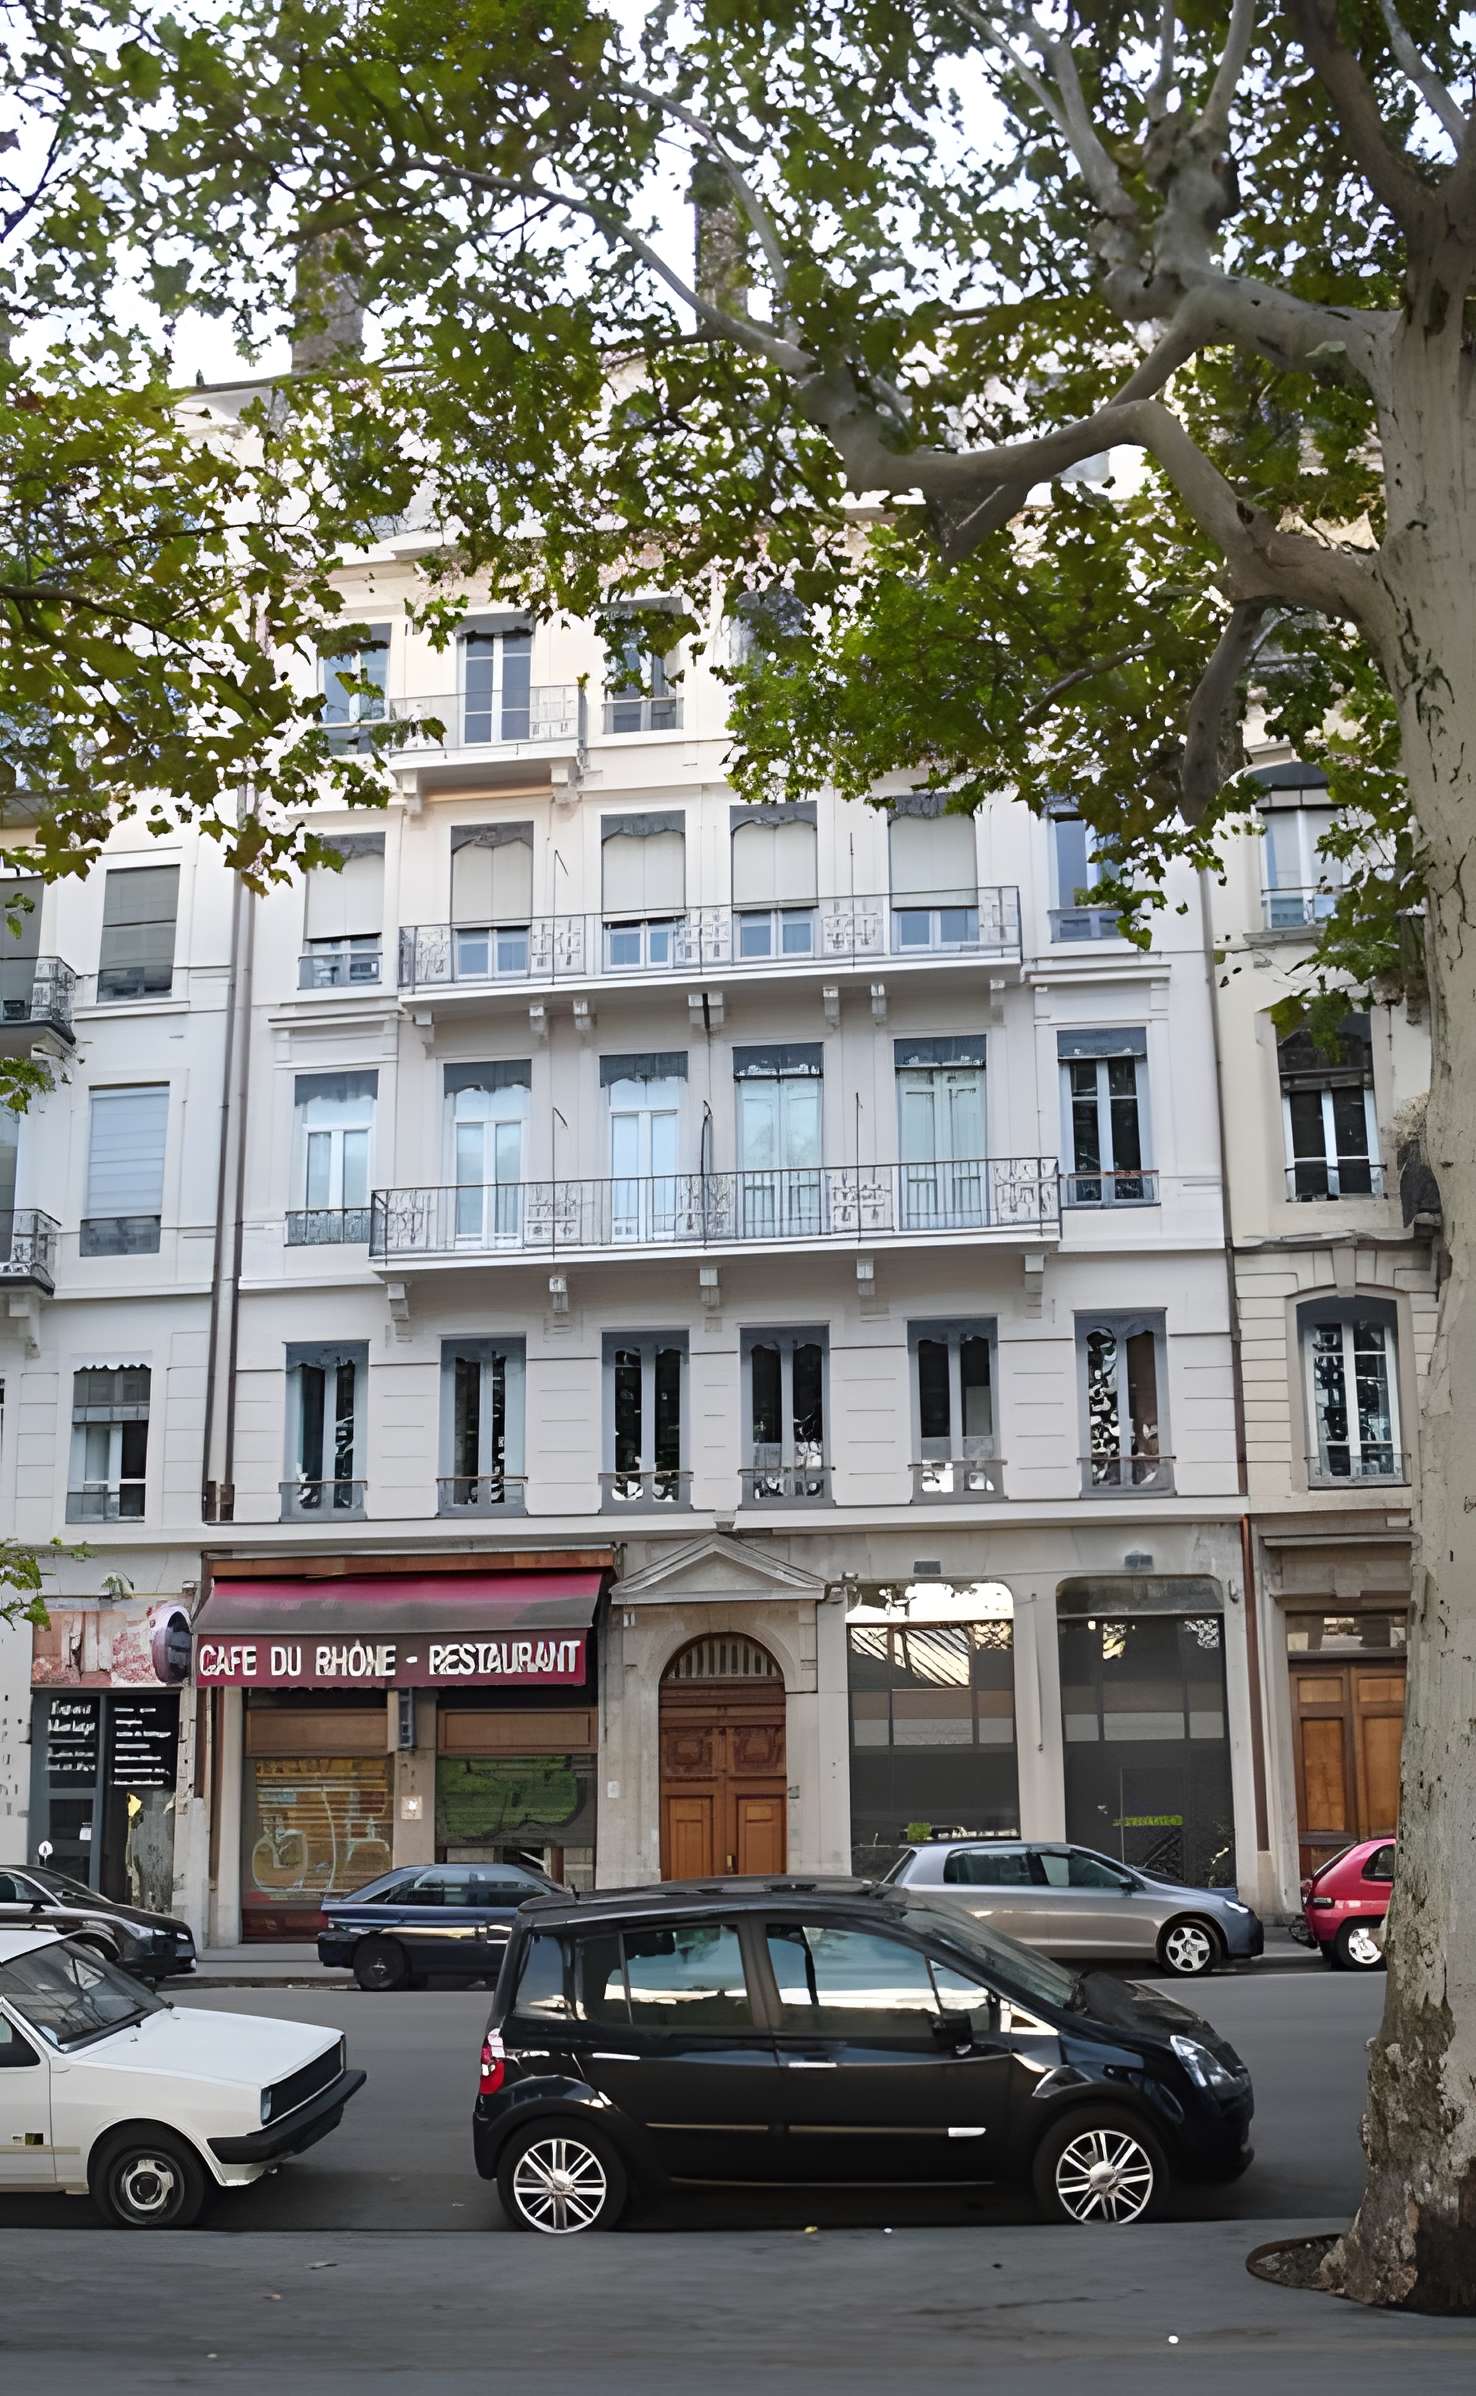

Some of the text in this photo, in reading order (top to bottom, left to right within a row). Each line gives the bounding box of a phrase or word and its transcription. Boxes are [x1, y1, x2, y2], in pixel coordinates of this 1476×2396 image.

[199, 1644, 257, 1677] CAFE
[270, 1646, 301, 1676] DU
[315, 1638, 397, 1677] RHÔNE
[429, 1640, 581, 1675] RESTAURANT
